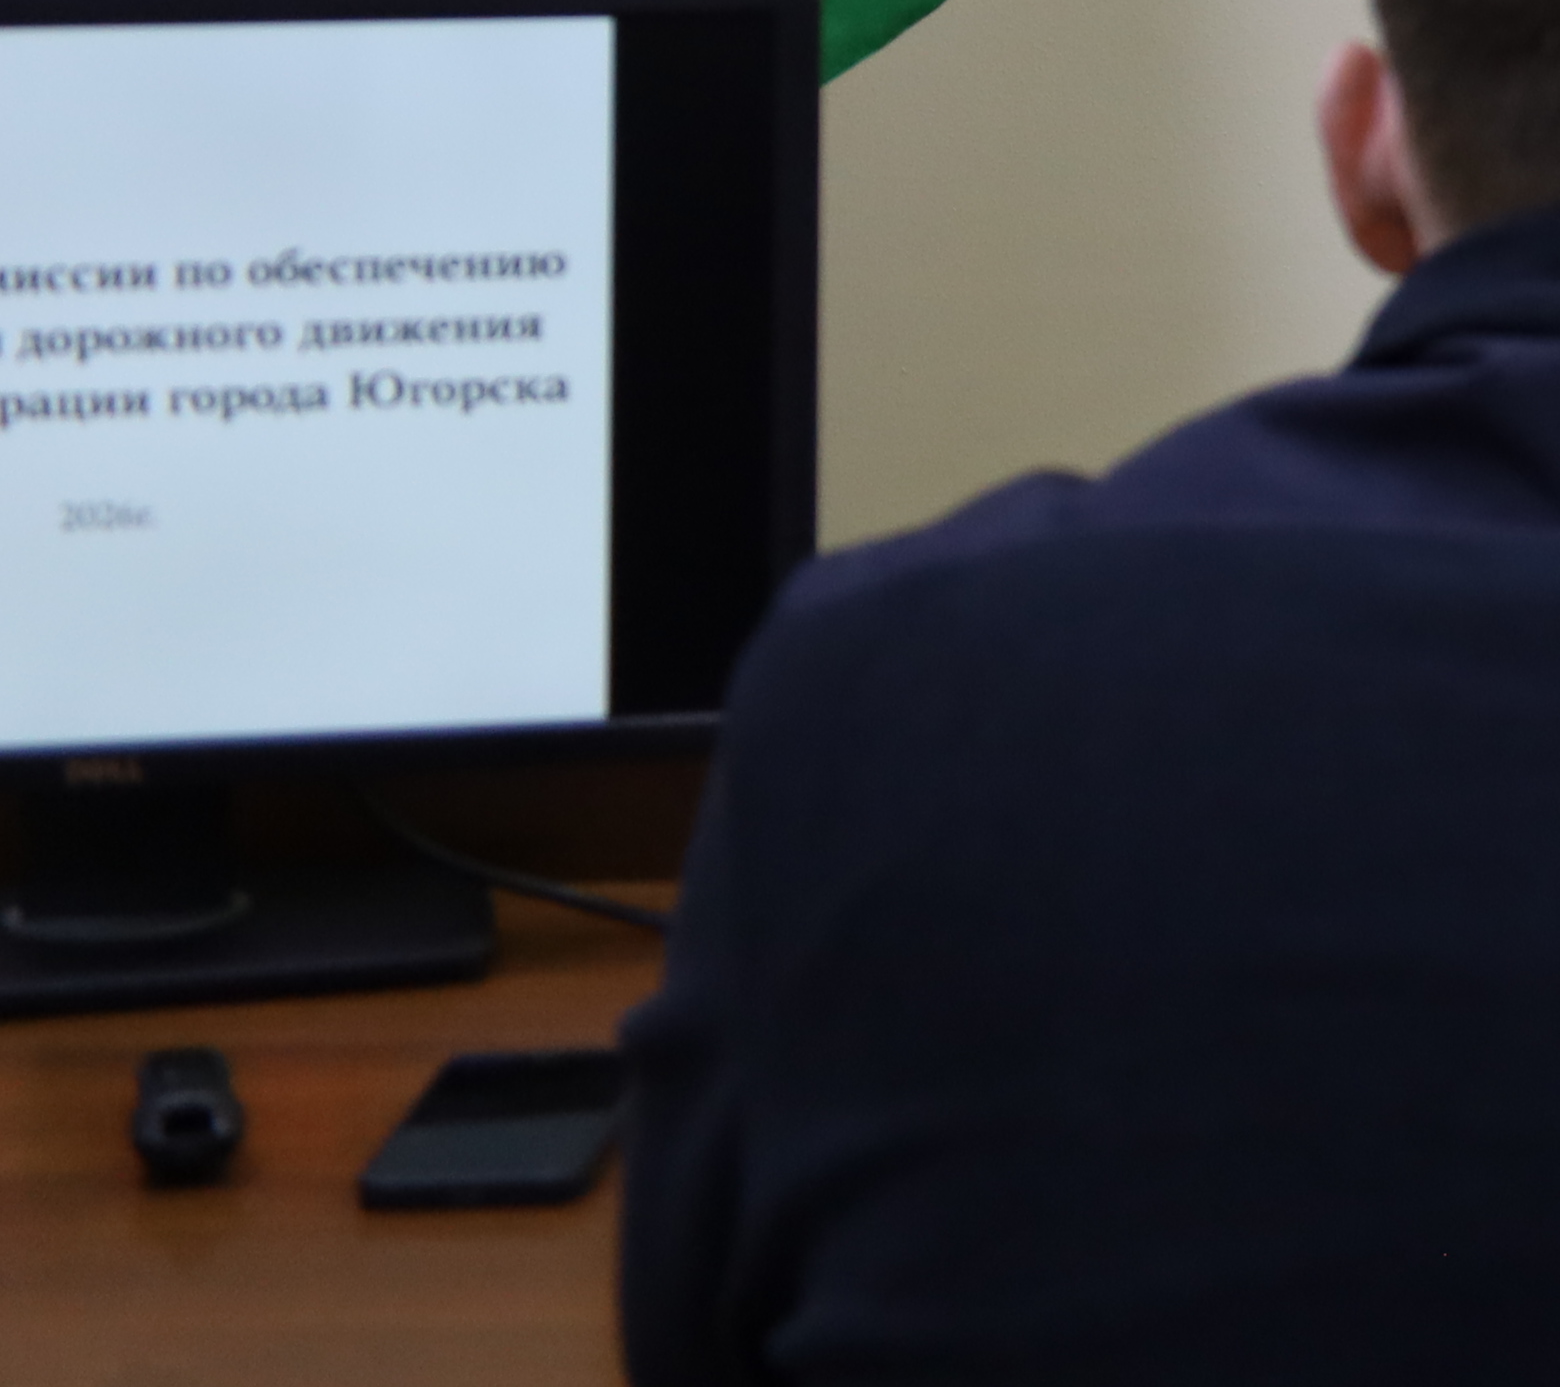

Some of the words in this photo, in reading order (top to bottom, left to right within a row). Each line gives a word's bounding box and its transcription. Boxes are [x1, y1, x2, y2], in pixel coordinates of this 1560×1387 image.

[173, 260, 234, 290] по
[246, 247, 568, 287] обеспечению
[15, 322, 284, 365] дорожного
[299, 313, 544, 353] движения
[168, 383, 331, 425] города
[348, 369, 571, 417] Югорска
